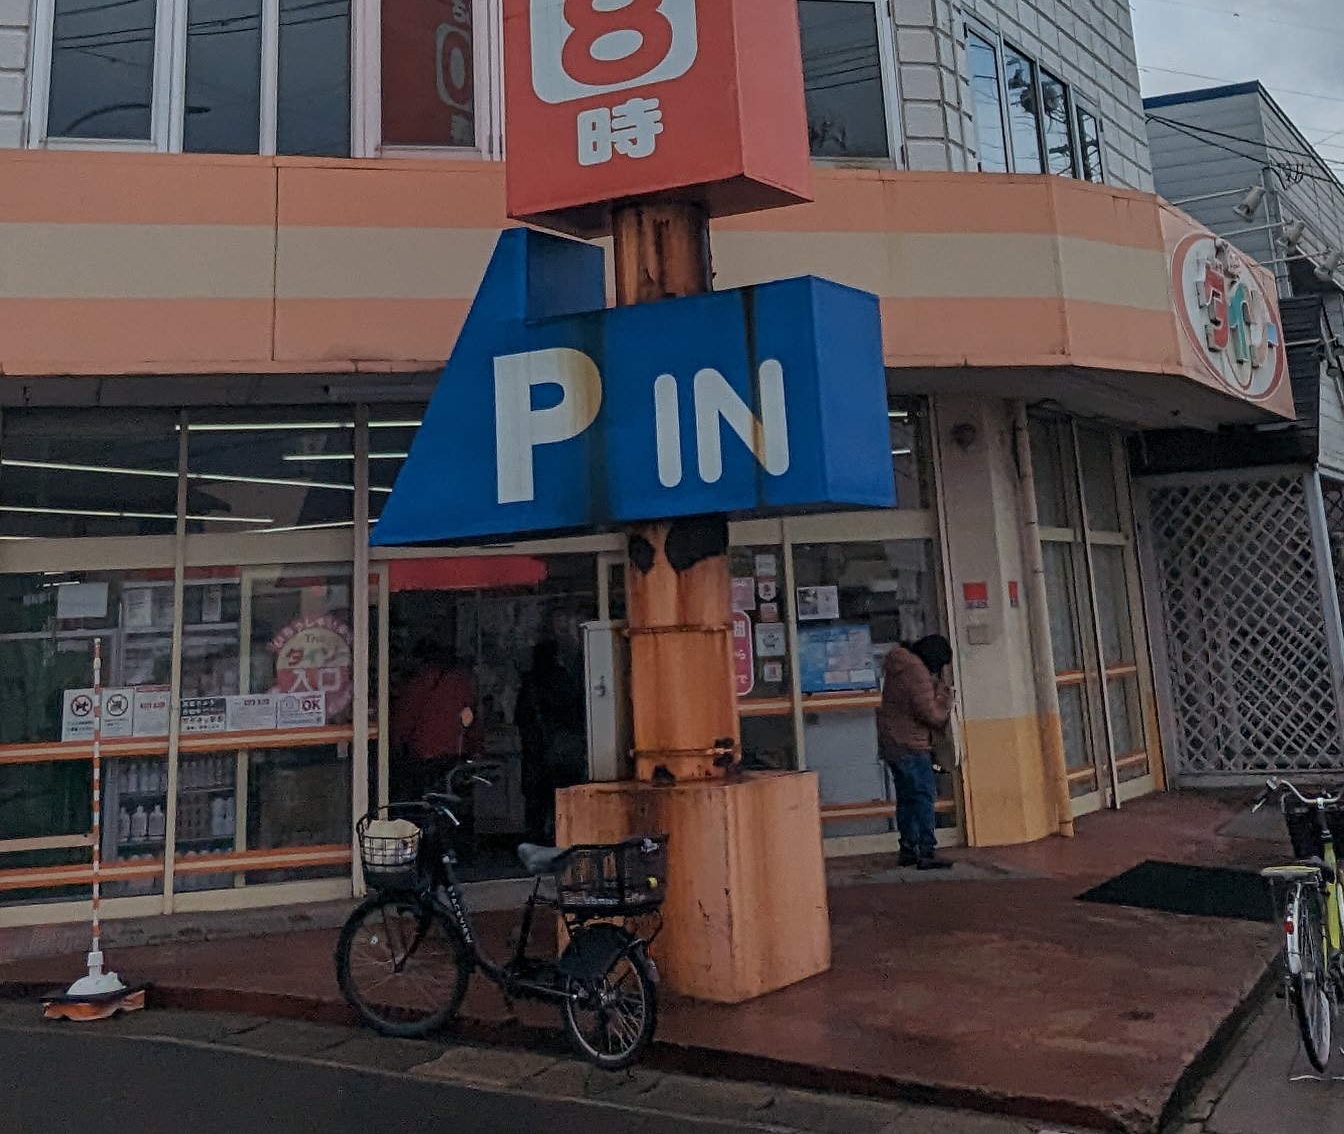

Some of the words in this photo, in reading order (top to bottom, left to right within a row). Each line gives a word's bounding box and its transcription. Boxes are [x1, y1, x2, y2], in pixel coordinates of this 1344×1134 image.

[576, 97, 664, 167] 時
[493, 346, 603, 504] P
[654, 358, 790, 488] IN
[289, 667, 341, 693] 入口
[302, 700, 321, 712] OK
